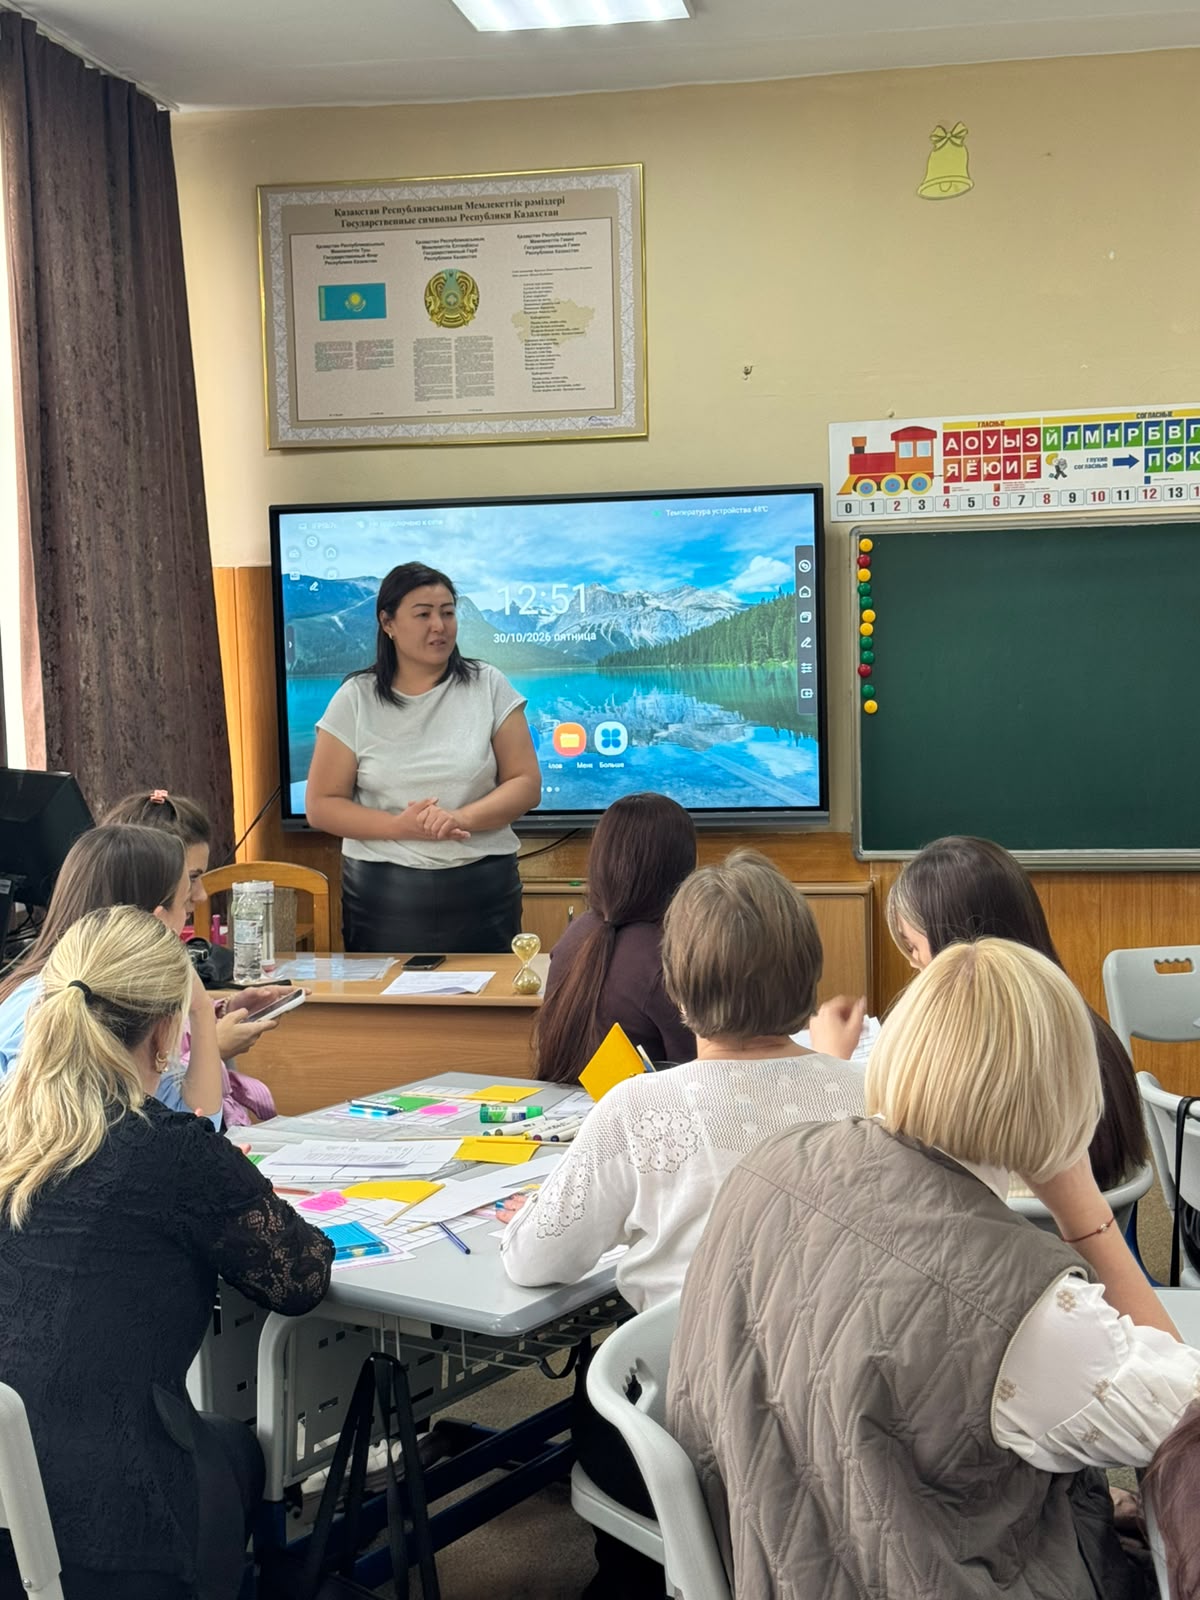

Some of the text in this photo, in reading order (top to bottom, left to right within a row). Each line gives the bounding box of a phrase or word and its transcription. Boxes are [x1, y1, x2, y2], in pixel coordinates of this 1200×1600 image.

[465, 199, 522, 210] Мемлекеттік
[341, 210, 559, 229] Государственные символы Республики Казахстан
[1136, 411, 1173, 419] СОГЛАСНЫЕ
[977, 420, 1006, 428] ГЛАСНЫЕ
[945, 433, 1038, 451] А О У Ы Э
[1045, 429, 1058, 446] Й
[1065, 431, 1078, 445] Л
[1085, 430, 1100, 444] М
[1107, 429, 1119, 443] Н
[1128, 428, 1140, 442] Р
[1148, 426, 1161, 440] Б
[1169, 425, 1182, 439] В
[1148, 453, 1160, 467] П
[1167, 452, 1183, 465] Ф
[946, 459, 1038, 477] Я Ё Ю И Е
[844, 502, 852, 513] 0
[869, 501, 875, 512] 1
[894, 500, 901, 511] 2
[918, 499, 926, 510] 3
[943, 498, 950, 509] 4
[968, 497, 975, 508] 5
[993, 495, 1000, 507] 6
[1017, 494, 1026, 505] 7
[1043, 493, 1051, 505] 8
[1068, 492, 1077, 503] 9
[1091, 491, 1106, 502] 10
[1117, 489, 1130, 501] 11
[1142, 488, 1157, 500] 12
[1168, 487, 1183, 498] 13
[666, 508, 711, 517] Температура
[712, 506, 752, 516] устройства
[497, 583, 586, 615] 12:51
[493, 631, 597, 643] 30/10/2026 пятница
